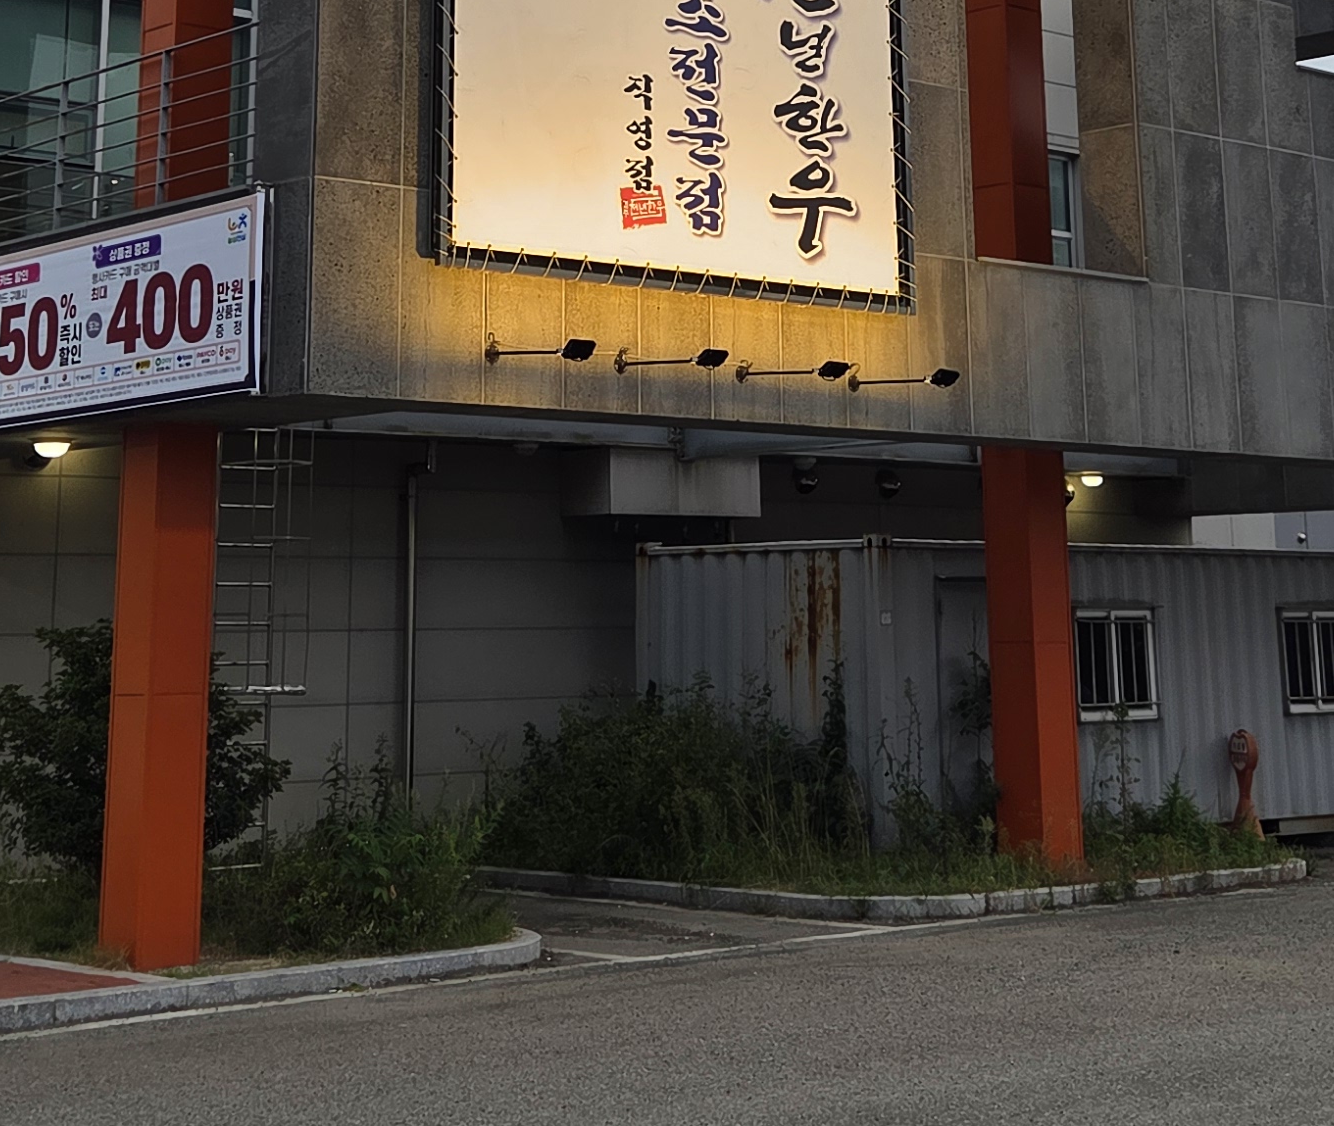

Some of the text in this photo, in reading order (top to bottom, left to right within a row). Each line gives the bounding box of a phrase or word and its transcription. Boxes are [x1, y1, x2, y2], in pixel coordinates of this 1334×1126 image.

[623, 74, 654, 192] 직영점
[109, 246, 132, 262] 상품권
[91, 285, 108, 301] 최대
[217, 278, 244, 304] 만원
[105, 263, 214, 355] 400
[216, 304, 243, 321] 상품권
[59, 322, 82, 344] 즉시
[58, 344, 82, 367] 할인
